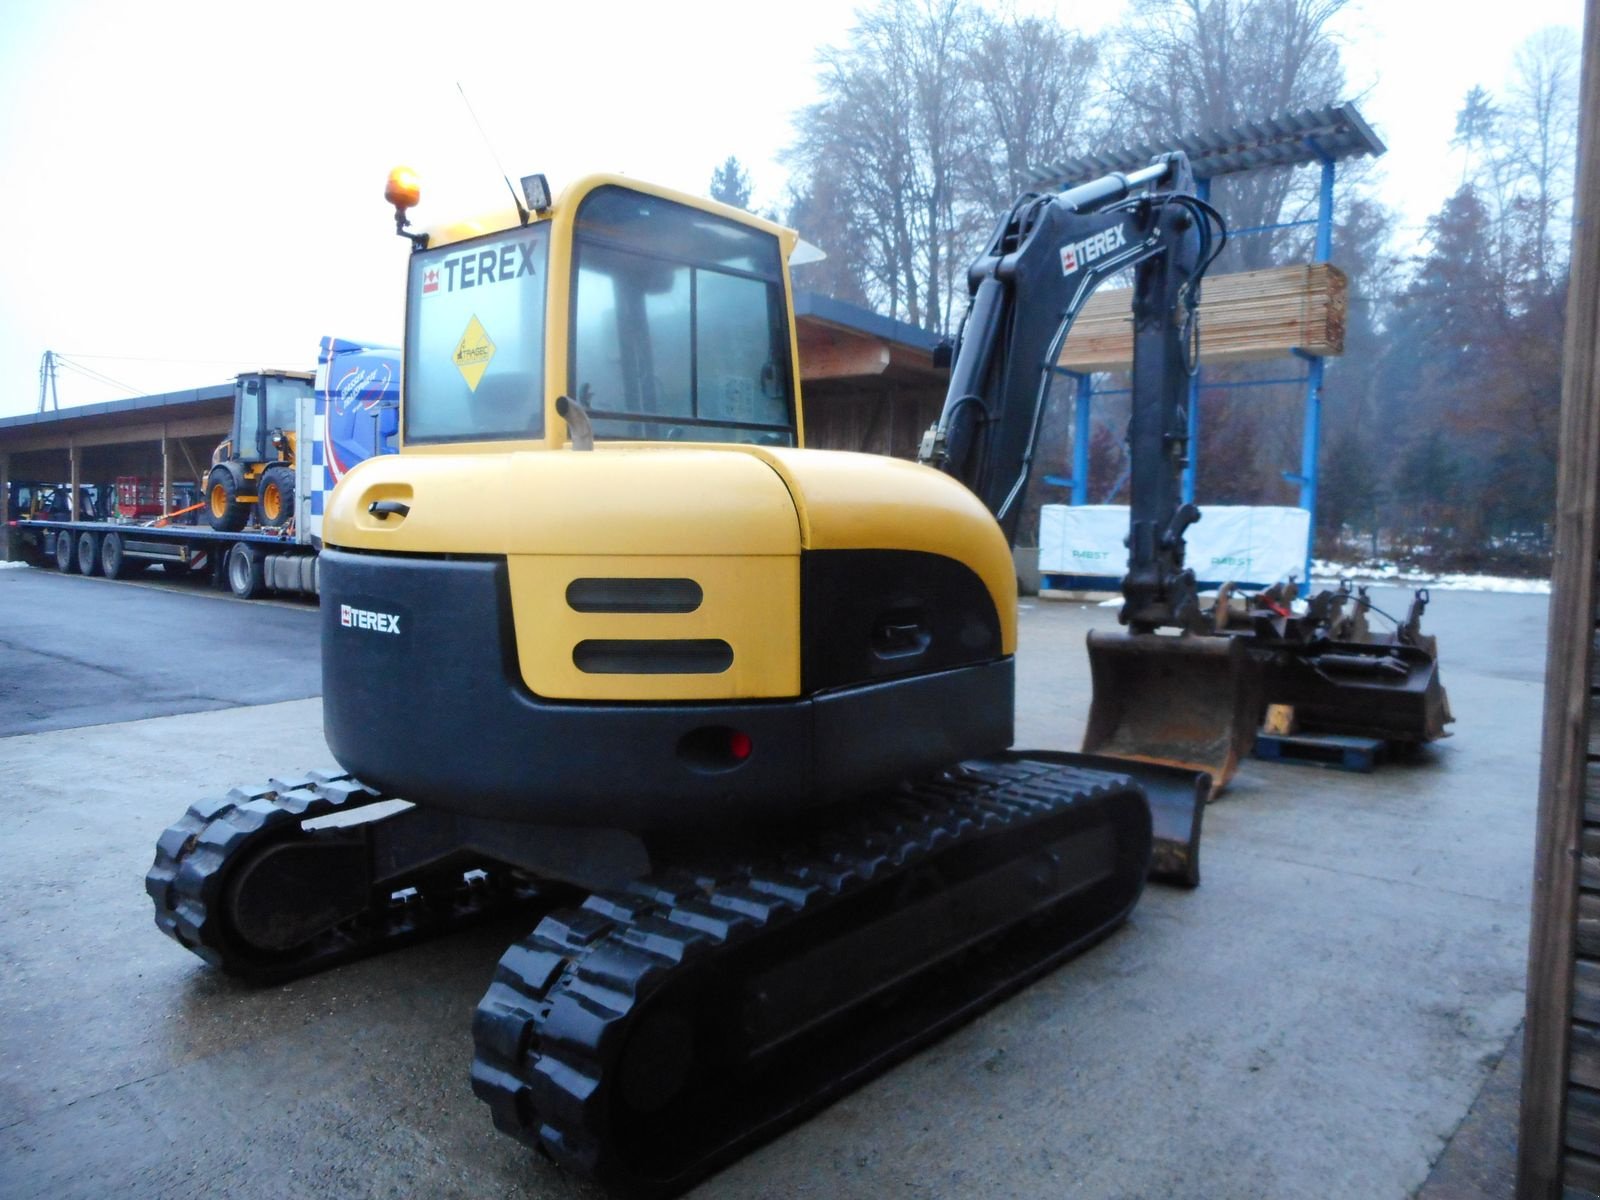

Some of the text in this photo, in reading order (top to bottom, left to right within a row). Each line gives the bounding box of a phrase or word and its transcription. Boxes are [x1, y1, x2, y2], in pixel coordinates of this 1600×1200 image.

[444, 239, 538, 293] TEREX
[1075, 222, 1127, 266] TEREX
[351, 608, 401, 634] TEREX
